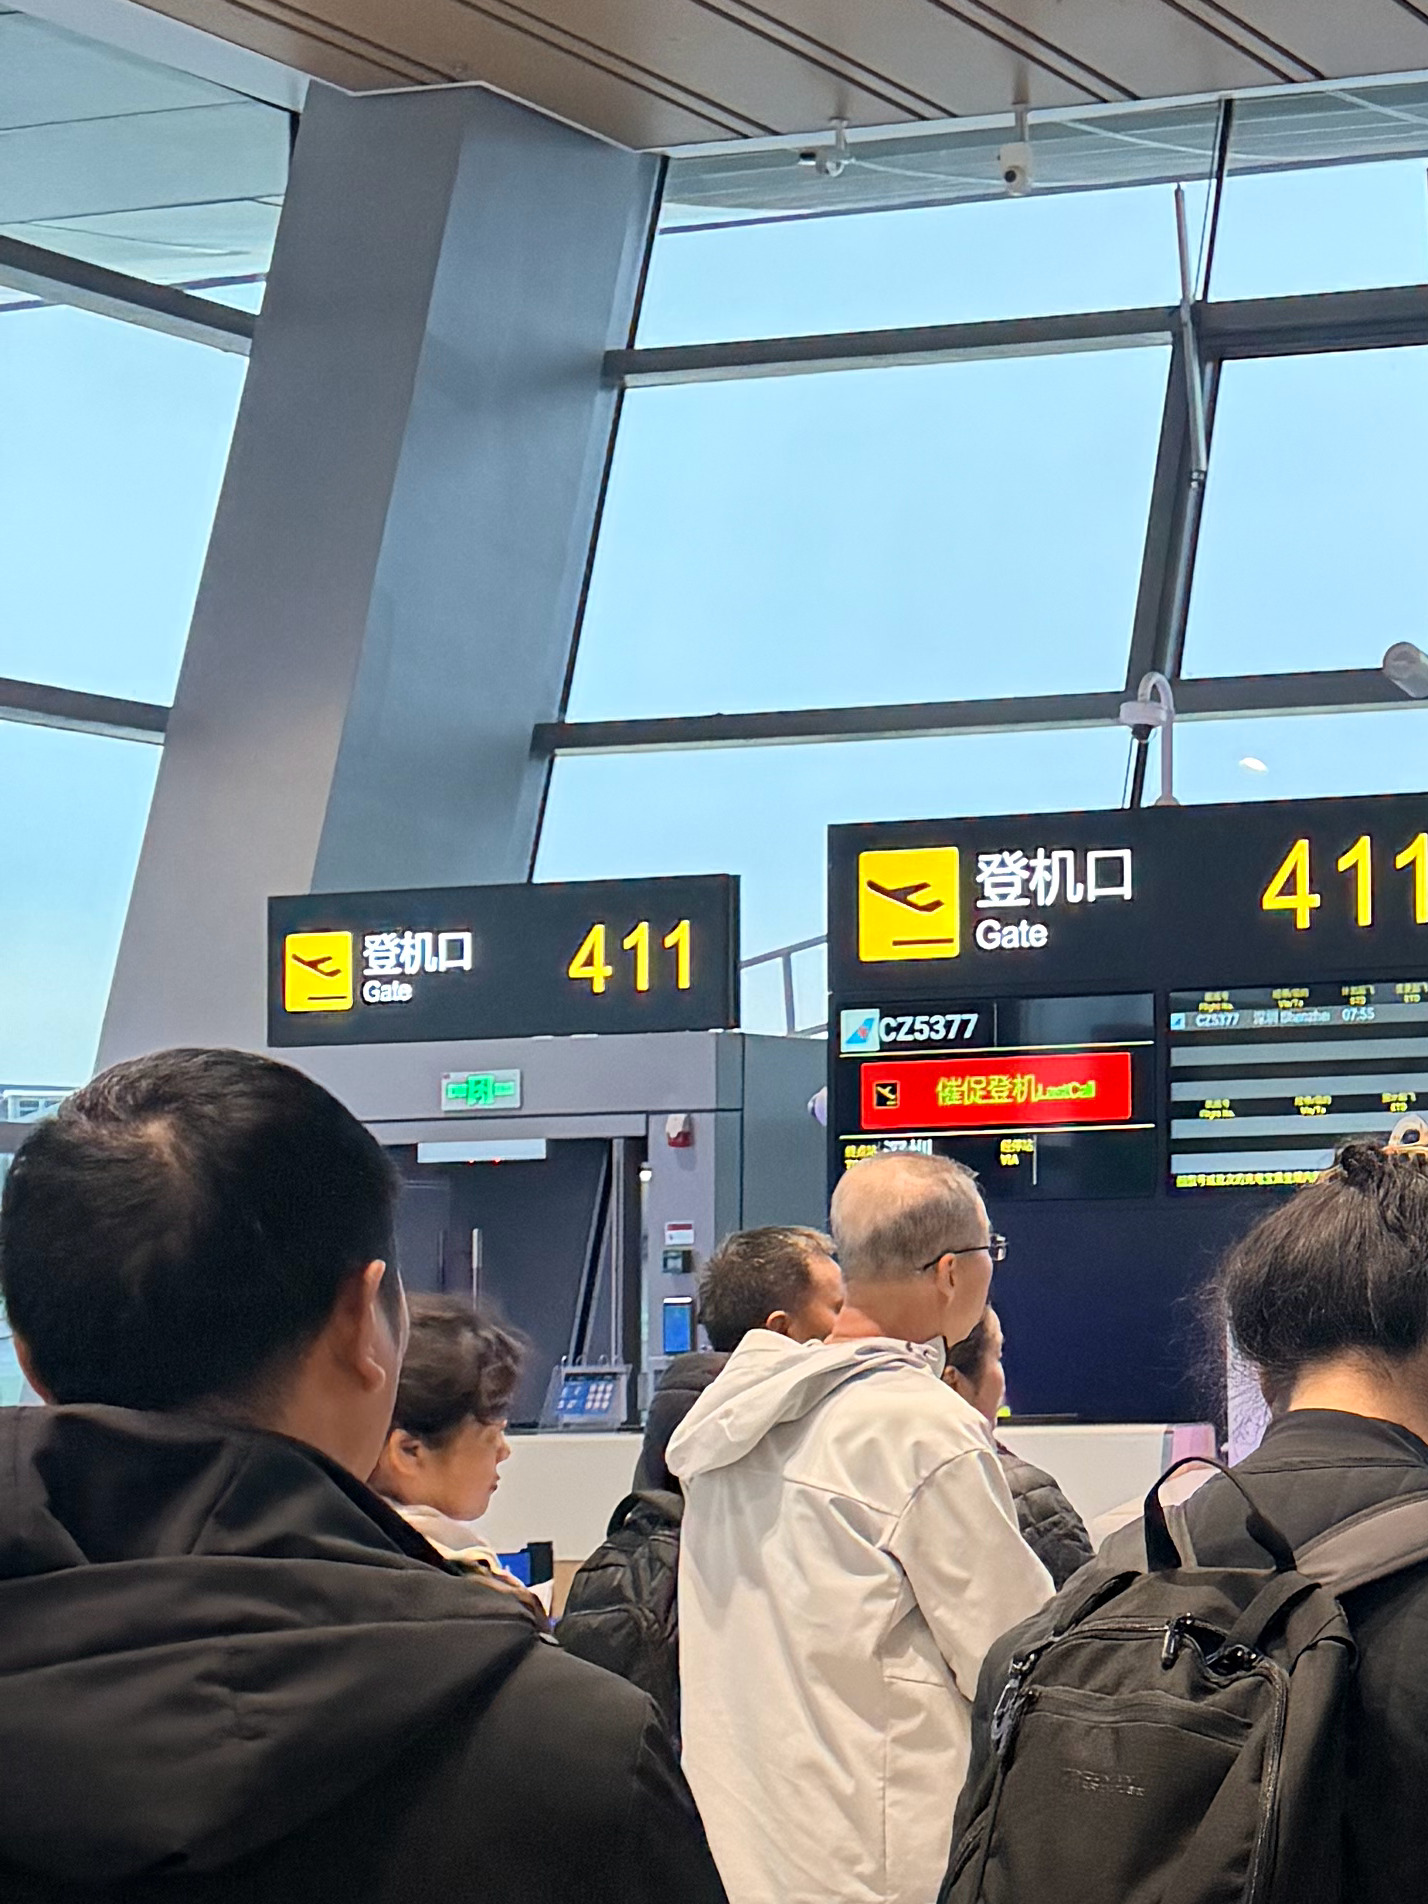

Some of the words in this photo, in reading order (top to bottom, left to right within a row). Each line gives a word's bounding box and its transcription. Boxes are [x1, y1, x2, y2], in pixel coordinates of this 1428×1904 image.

[974, 847, 1134, 910] 登机口
[361, 931, 474, 975] 登机口
[974, 919, 1049, 954] Gate
[567, 918, 693, 994] 411
[361, 980, 414, 1004] Gate
[879, 1013, 979, 1043] CZ5377
[1342, 1007, 1375, 1022] 07:55
